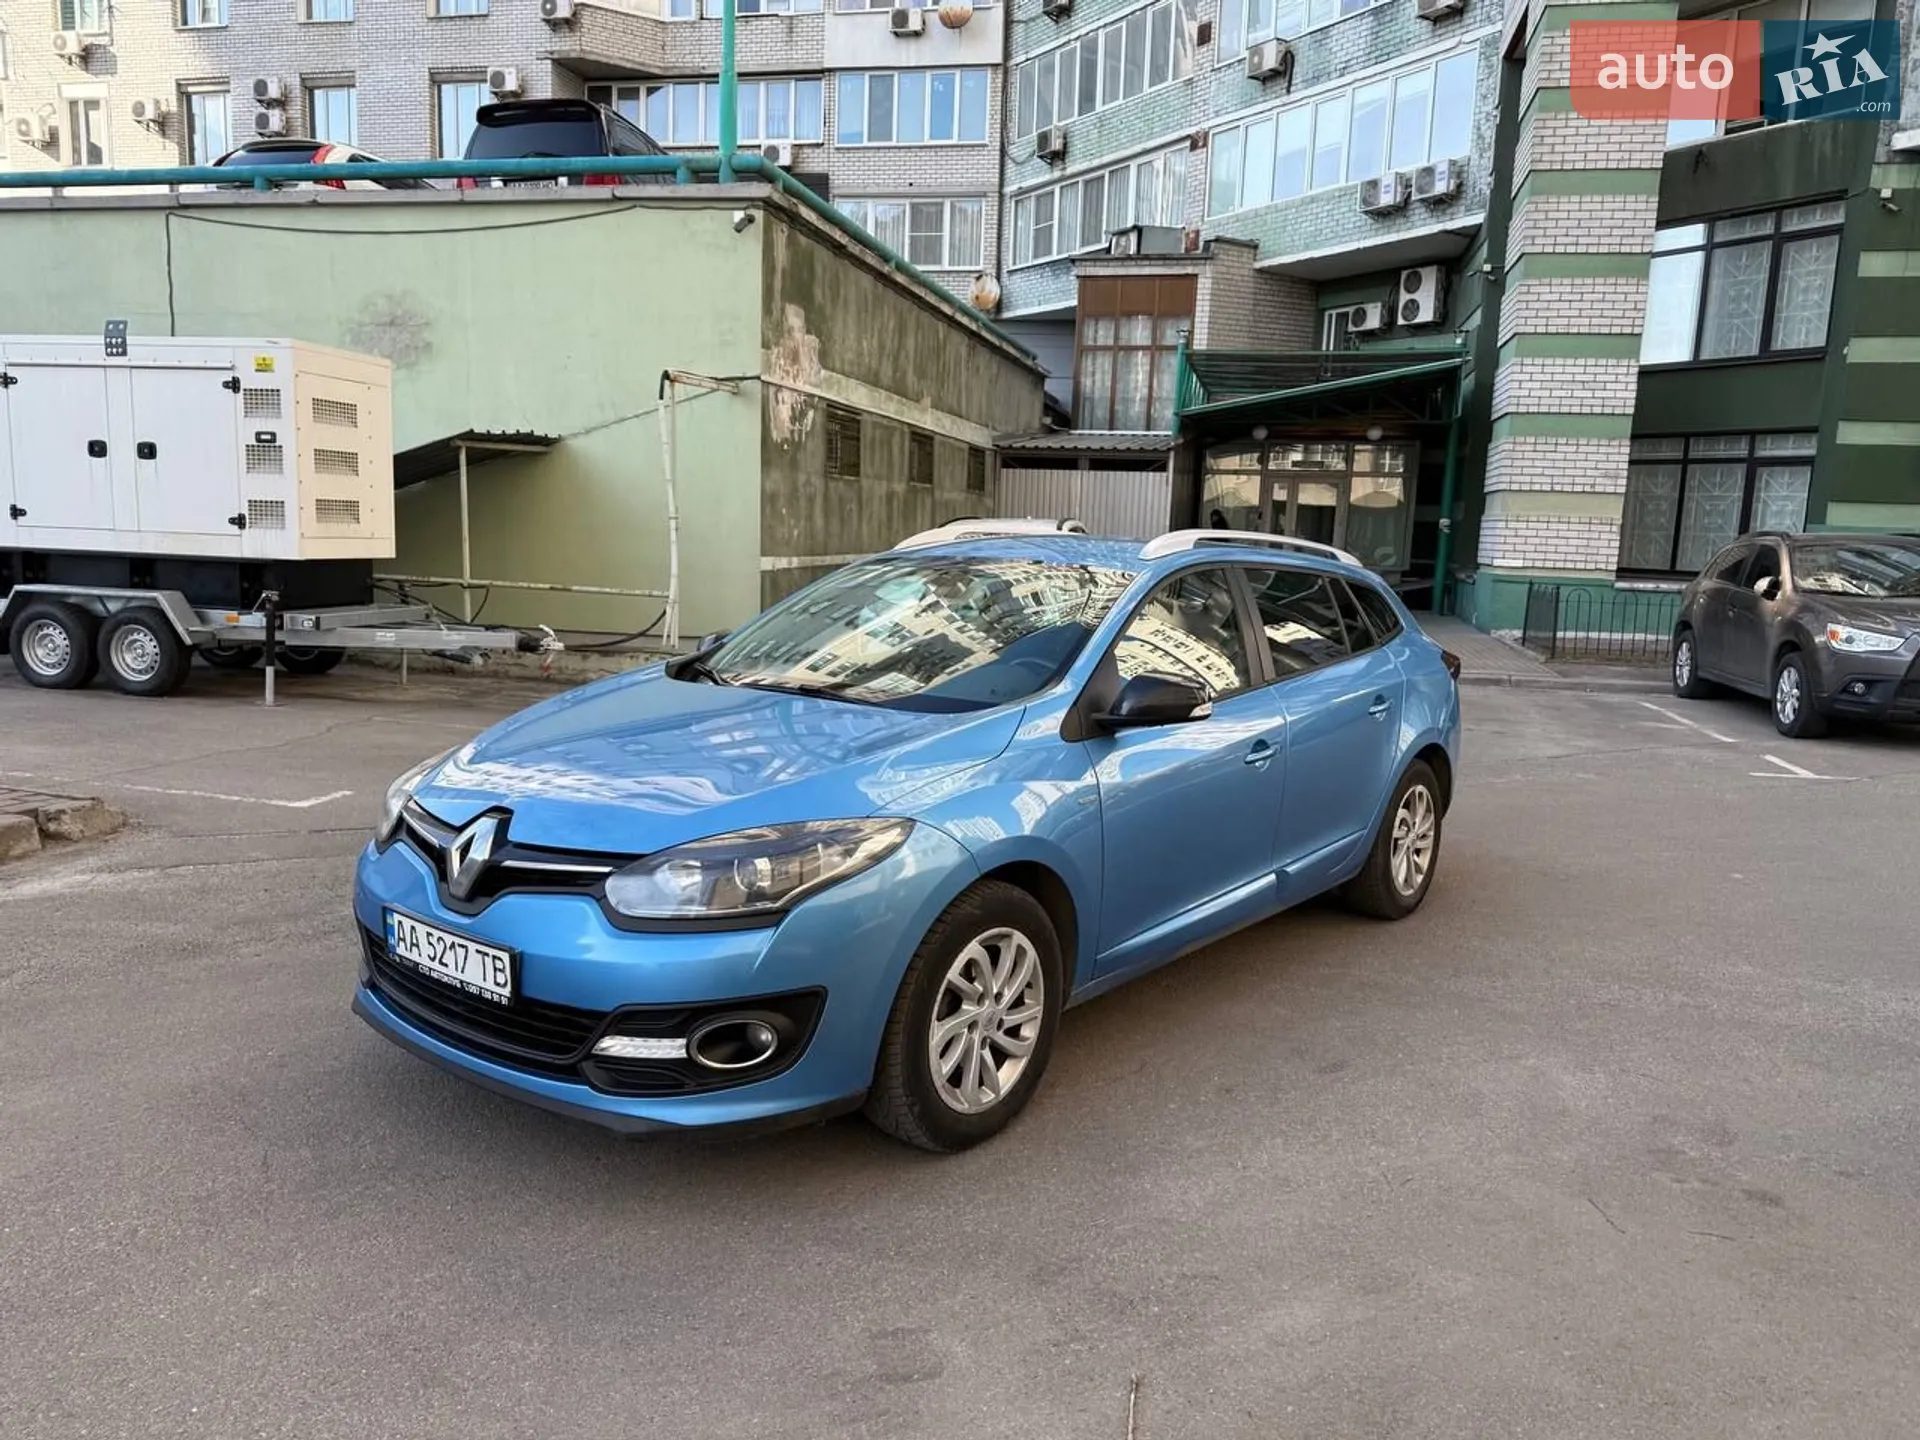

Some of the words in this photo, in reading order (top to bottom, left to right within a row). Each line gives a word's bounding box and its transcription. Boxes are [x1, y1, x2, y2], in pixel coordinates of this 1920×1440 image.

[397, 919, 422, 957] AA
[426, 930, 469, 974] 5217
[475, 949, 509, 988] TB
